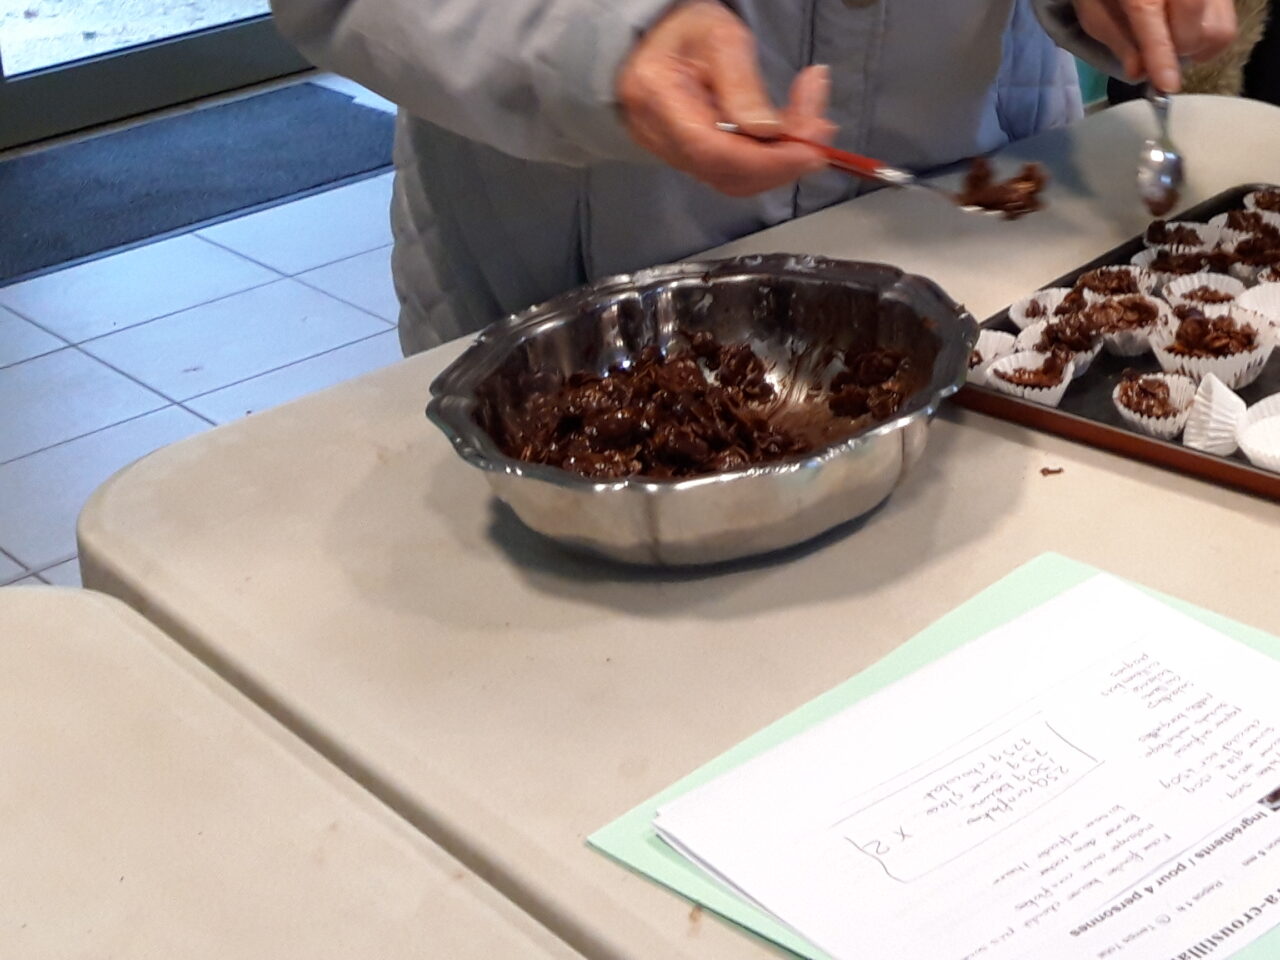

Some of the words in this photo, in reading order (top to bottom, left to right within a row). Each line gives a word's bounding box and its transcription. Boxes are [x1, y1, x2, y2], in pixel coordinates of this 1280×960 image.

[862, 838, 891, 858] 2
[1194, 810, 1269, 859] Ingrédients
[1155, 861, 1188, 887] pour
[1069, 890, 1144, 937] personnes
